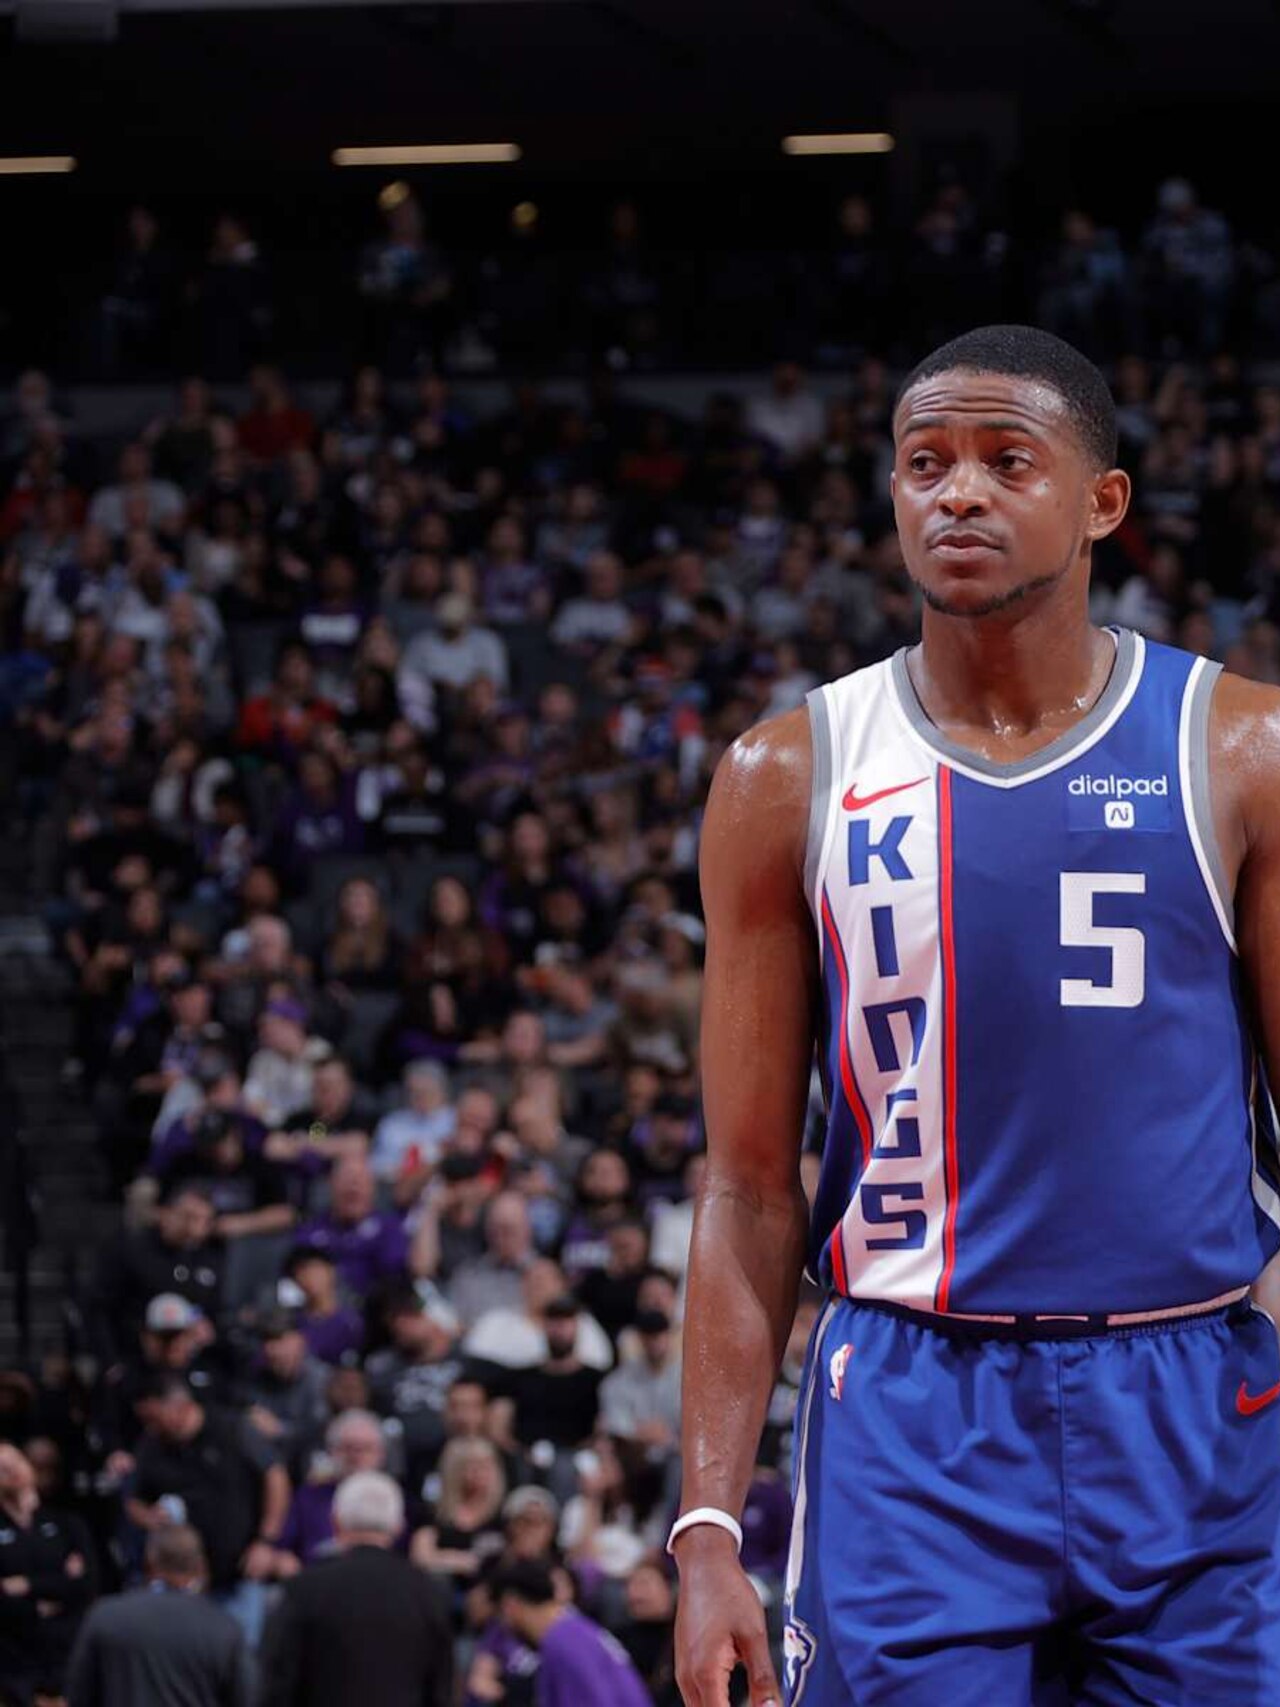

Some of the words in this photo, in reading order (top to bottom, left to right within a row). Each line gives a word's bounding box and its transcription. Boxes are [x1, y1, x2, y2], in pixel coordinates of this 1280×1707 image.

[1067, 773, 1168, 799] dialpad
[1059, 873, 1145, 1007] 5
[847, 815, 927, 1251] KINGS
